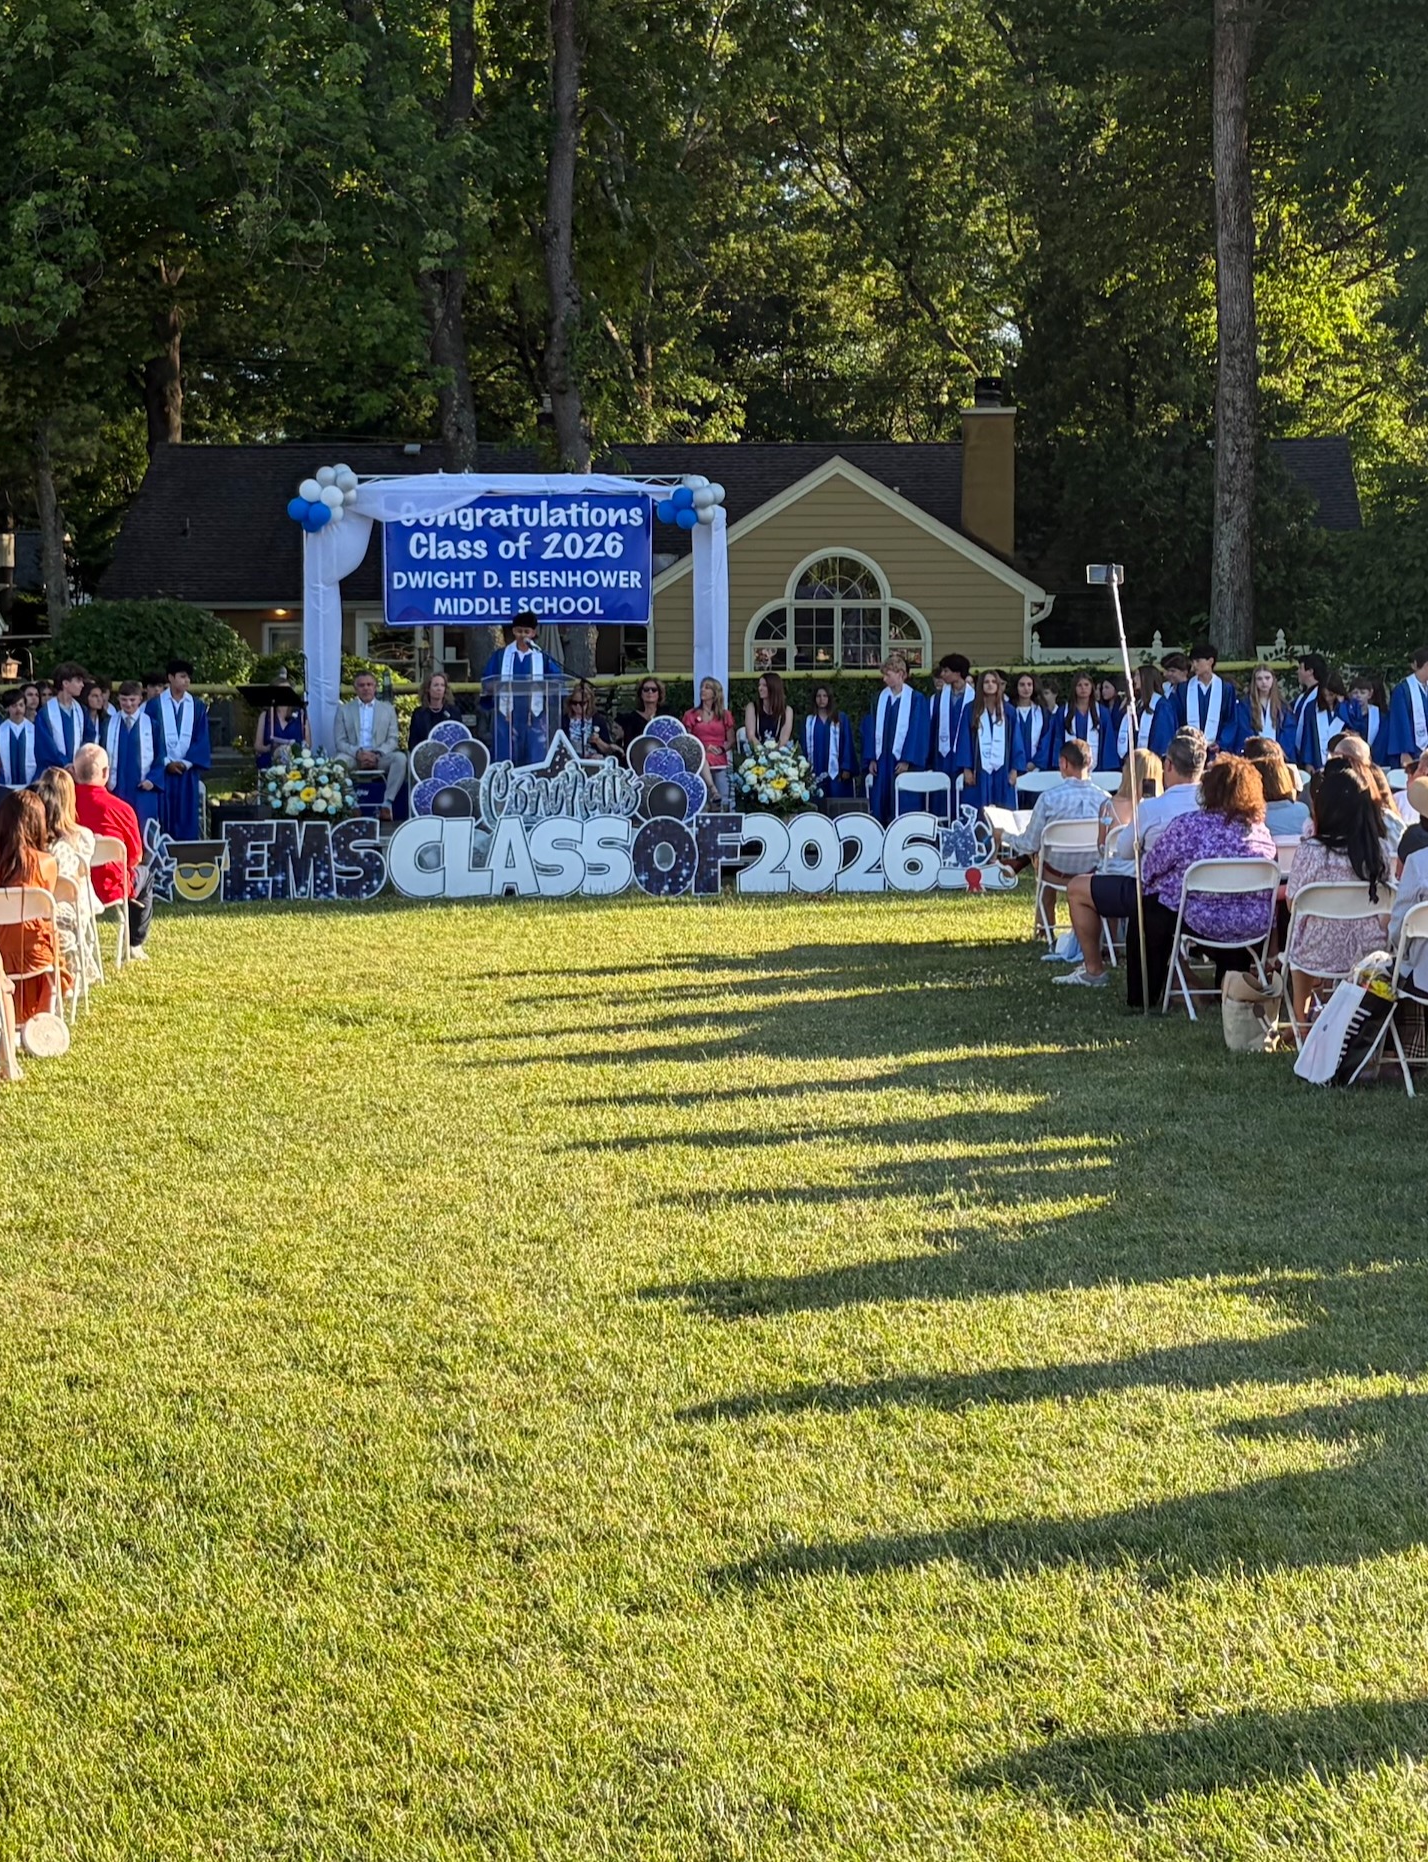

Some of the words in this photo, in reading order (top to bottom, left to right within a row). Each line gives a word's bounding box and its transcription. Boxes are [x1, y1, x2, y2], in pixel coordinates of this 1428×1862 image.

[400, 500, 644, 531] Congratulations
[409, 532, 488, 560] Class
[498, 531, 532, 560] of
[540, 532, 624, 560] 2026
[393, 571, 476, 589] DWIGHT
[483, 571, 503, 588] D.
[510, 570, 642, 588] EISENHOWER
[434, 598, 511, 615] MIDDLE
[518, 597, 604, 615] SCHOOL
[222, 818, 387, 902] EMS
[388, 815, 633, 897] CLASS
[632, 813, 745, 896] OF
[736, 811, 944, 894] 2026
